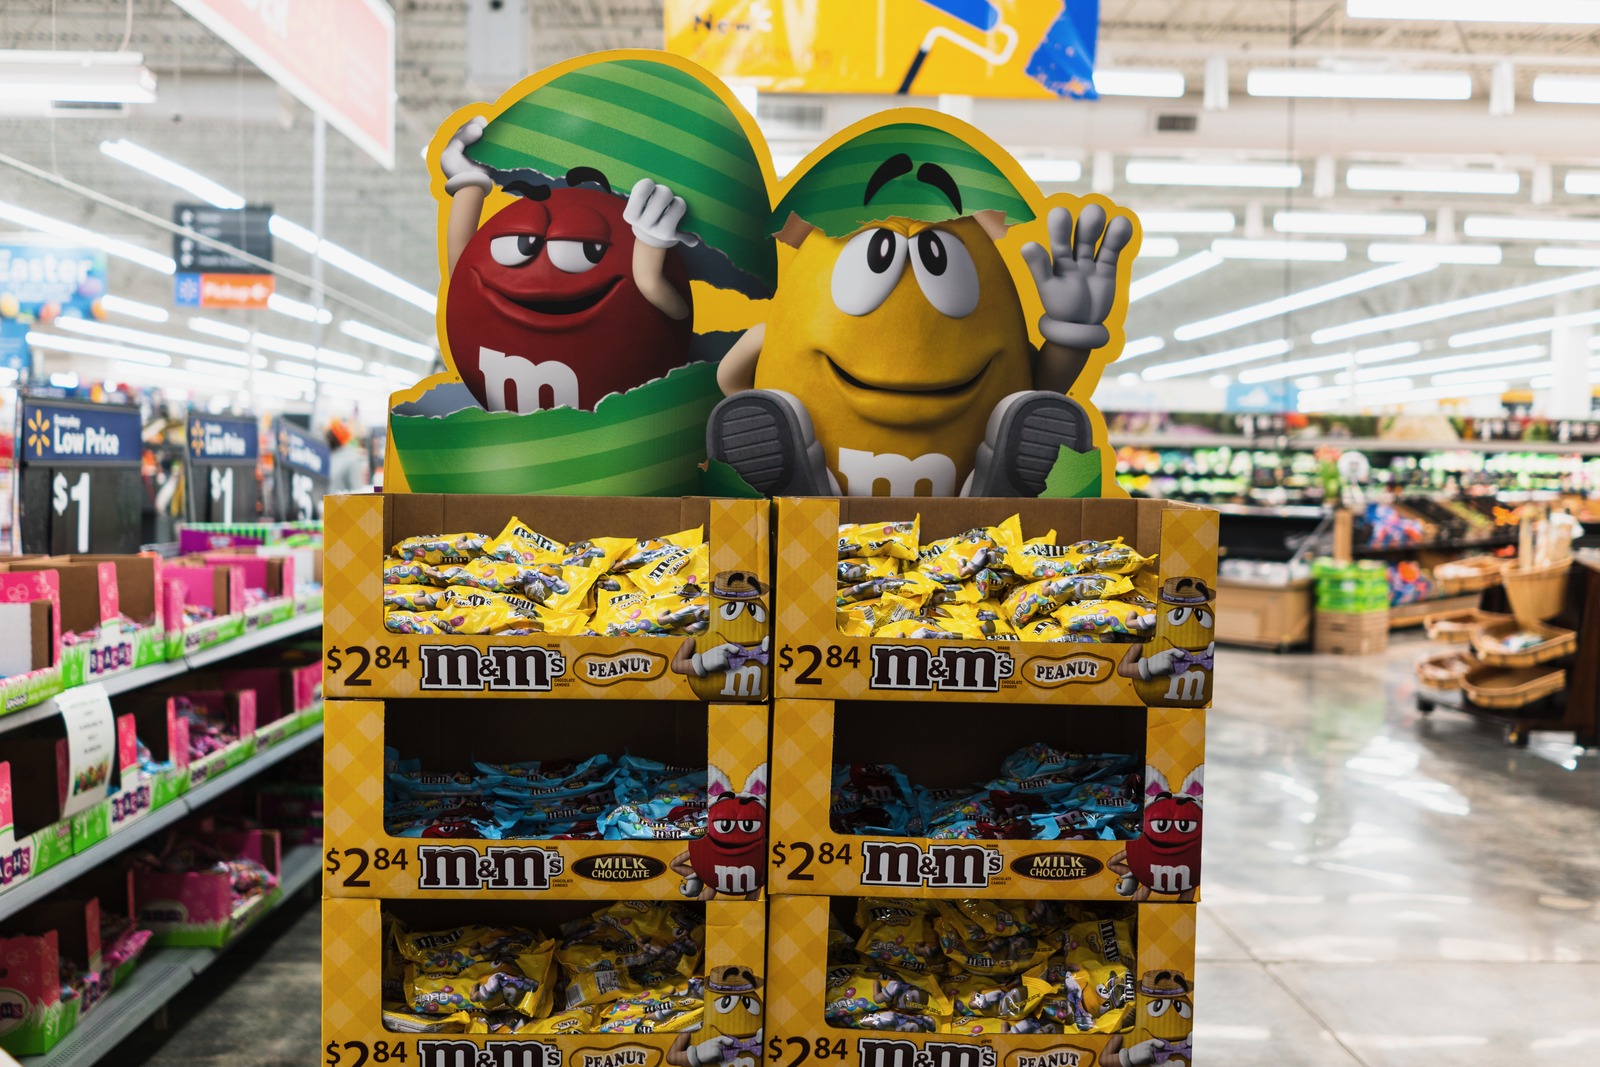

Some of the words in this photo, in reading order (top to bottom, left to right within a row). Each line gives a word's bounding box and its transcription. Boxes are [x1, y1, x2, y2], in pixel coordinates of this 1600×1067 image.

[479, 346, 579, 416] m
[54, 425, 84, 454] Low
[85, 427, 119, 455] Price
[838, 447, 957, 497] m
[53, 472, 90, 553] $1
[588, 658, 651, 678] PEANUT
[1035, 661, 1098, 681] PEANUT
[720, 664, 761, 697] m
[1164, 669, 1206, 701] m
[591, 869, 650, 879] CHOCOLATE
[594, 857, 648, 869] MILK
[1029, 867, 1087, 878] CHOCOLATE
[1033, 856, 1085, 868] MILK
[714, 865, 758, 893] m
[1150, 864, 1193, 892] m
[583, 1051, 647, 1067] PEANUT
[1018, 1052, 1079, 1067] PEANUT
